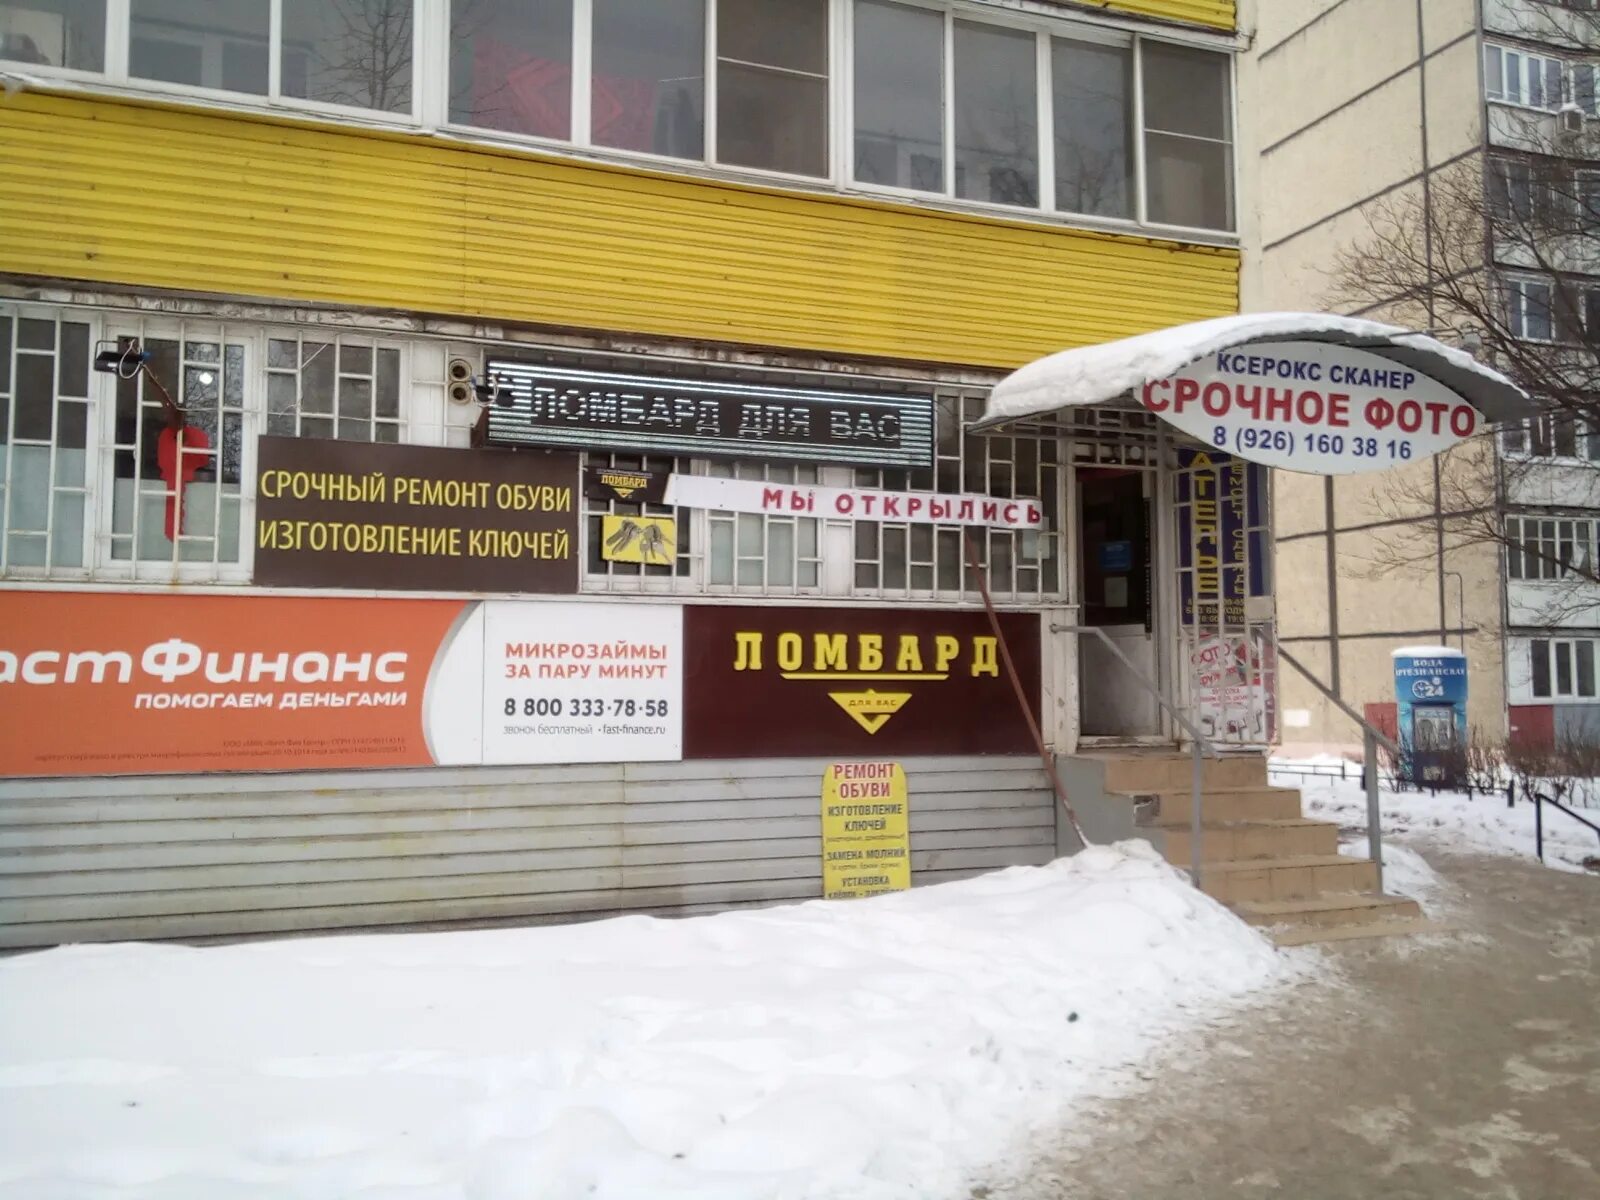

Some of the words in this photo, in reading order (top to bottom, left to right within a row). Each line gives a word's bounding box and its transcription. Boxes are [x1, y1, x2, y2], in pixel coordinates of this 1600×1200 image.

[1217, 353, 1321, 381] КСЕРОКС
[1330, 366, 1414, 390] СКАНЕР
[533, 387, 720, 437] ЛОМБАРД
[738, 404, 810, 439] ДЛЯ
[830, 411, 900, 441] ВАС
[1142, 378, 1349, 427] СРОЧНОЕ
[1365, 398, 1475, 437] ФОТО
[1213, 426, 1226, 445] 8
[1236, 428, 1294, 456] (926)
[1304, 434, 1343, 455] 160
[1352, 437, 1377, 457] 38
[1387, 440, 1410, 460] 16
[601, 474, 648, 489] ЛОМБАРД
[261, 470, 385, 502] СРОЧНЫЙ
[394, 477, 490, 508] РЕМОНТ
[496, 484, 571, 512] ОБУВИ
[763, 488, 814, 512] МЫ
[835, 494, 1041, 523] ОТКРЫЛИСЬ
[259, 520, 461, 556] ИЗГОТОВЛЕНИЕ
[469, 529, 569, 559] КЛЮЧЕЙ
[505, 640, 667, 659] МИКРОЗАЙМЫ
[734, 632, 999, 677] ЛОМБАРД
[505, 664, 531, 678] ЗА
[538, 664, 591, 679] ПАРУ
[599, 665, 667, 679] МИНУТ
[1425, 685, 1444, 697] 24
[134, 692, 273, 709] ПОМОГАЕМ
[279, 691, 408, 710] ДЕНЬГАМИ
[504, 698, 516, 716] 8
[524, 698, 562, 716] 800
[503, 725, 536, 735] звонок
[537, 723, 593, 736] бесплатный
[602, 723, 666, 735] fast-finance.ru
[833, 762, 896, 780] РЕМОНТ
[840, 782, 891, 799] ОБУВИ
[828, 804, 903, 817] ИЗГОТОВЛЕНИЕ
[844, 817, 887, 832] КЛЮЧЕЙ
[827, 851, 864, 861] ЗАМЕНА
[866, 848, 906, 859] МОЛНИЙ
[841, 875, 890, 888] УСТАНОВКА
